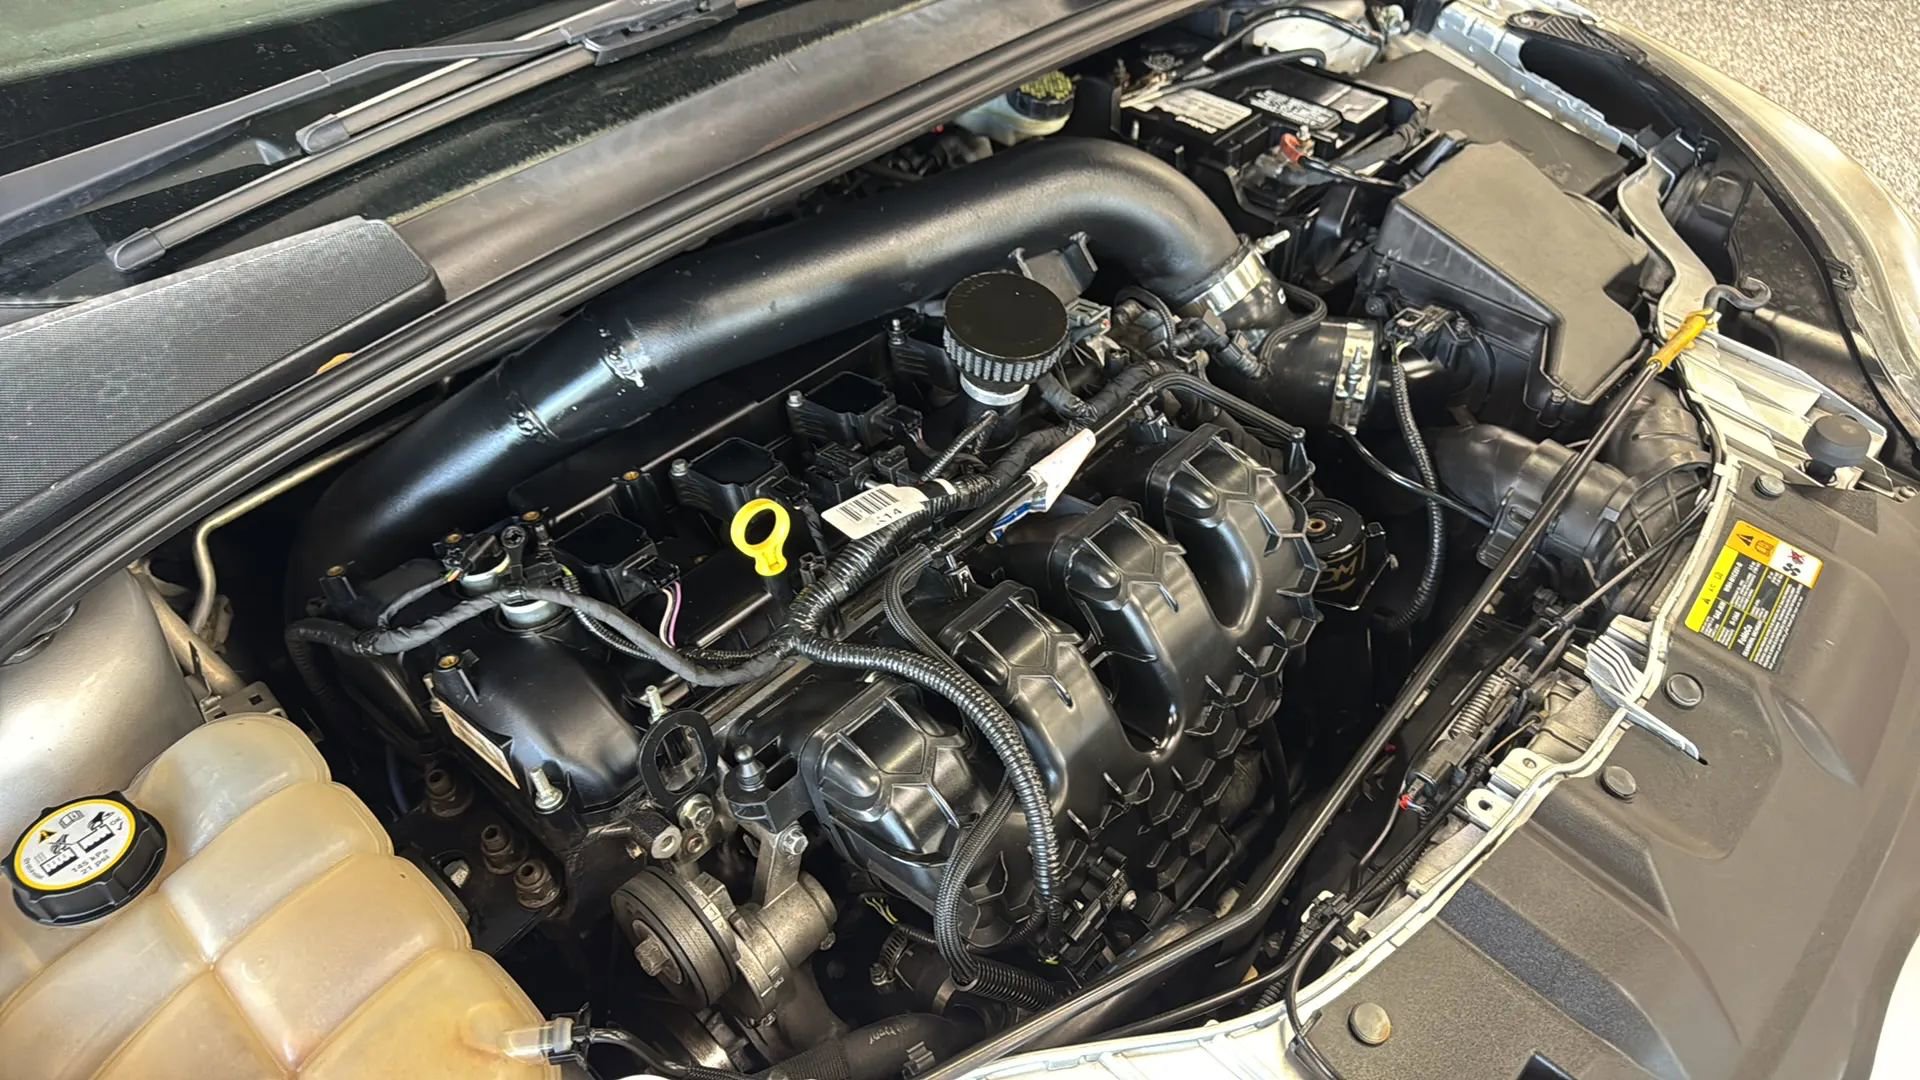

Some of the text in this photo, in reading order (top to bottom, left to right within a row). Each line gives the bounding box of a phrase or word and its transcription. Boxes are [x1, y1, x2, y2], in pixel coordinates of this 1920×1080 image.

[72, 849, 108, 872] 145 kPa
[80, 855, 110, 875] 21 psi
